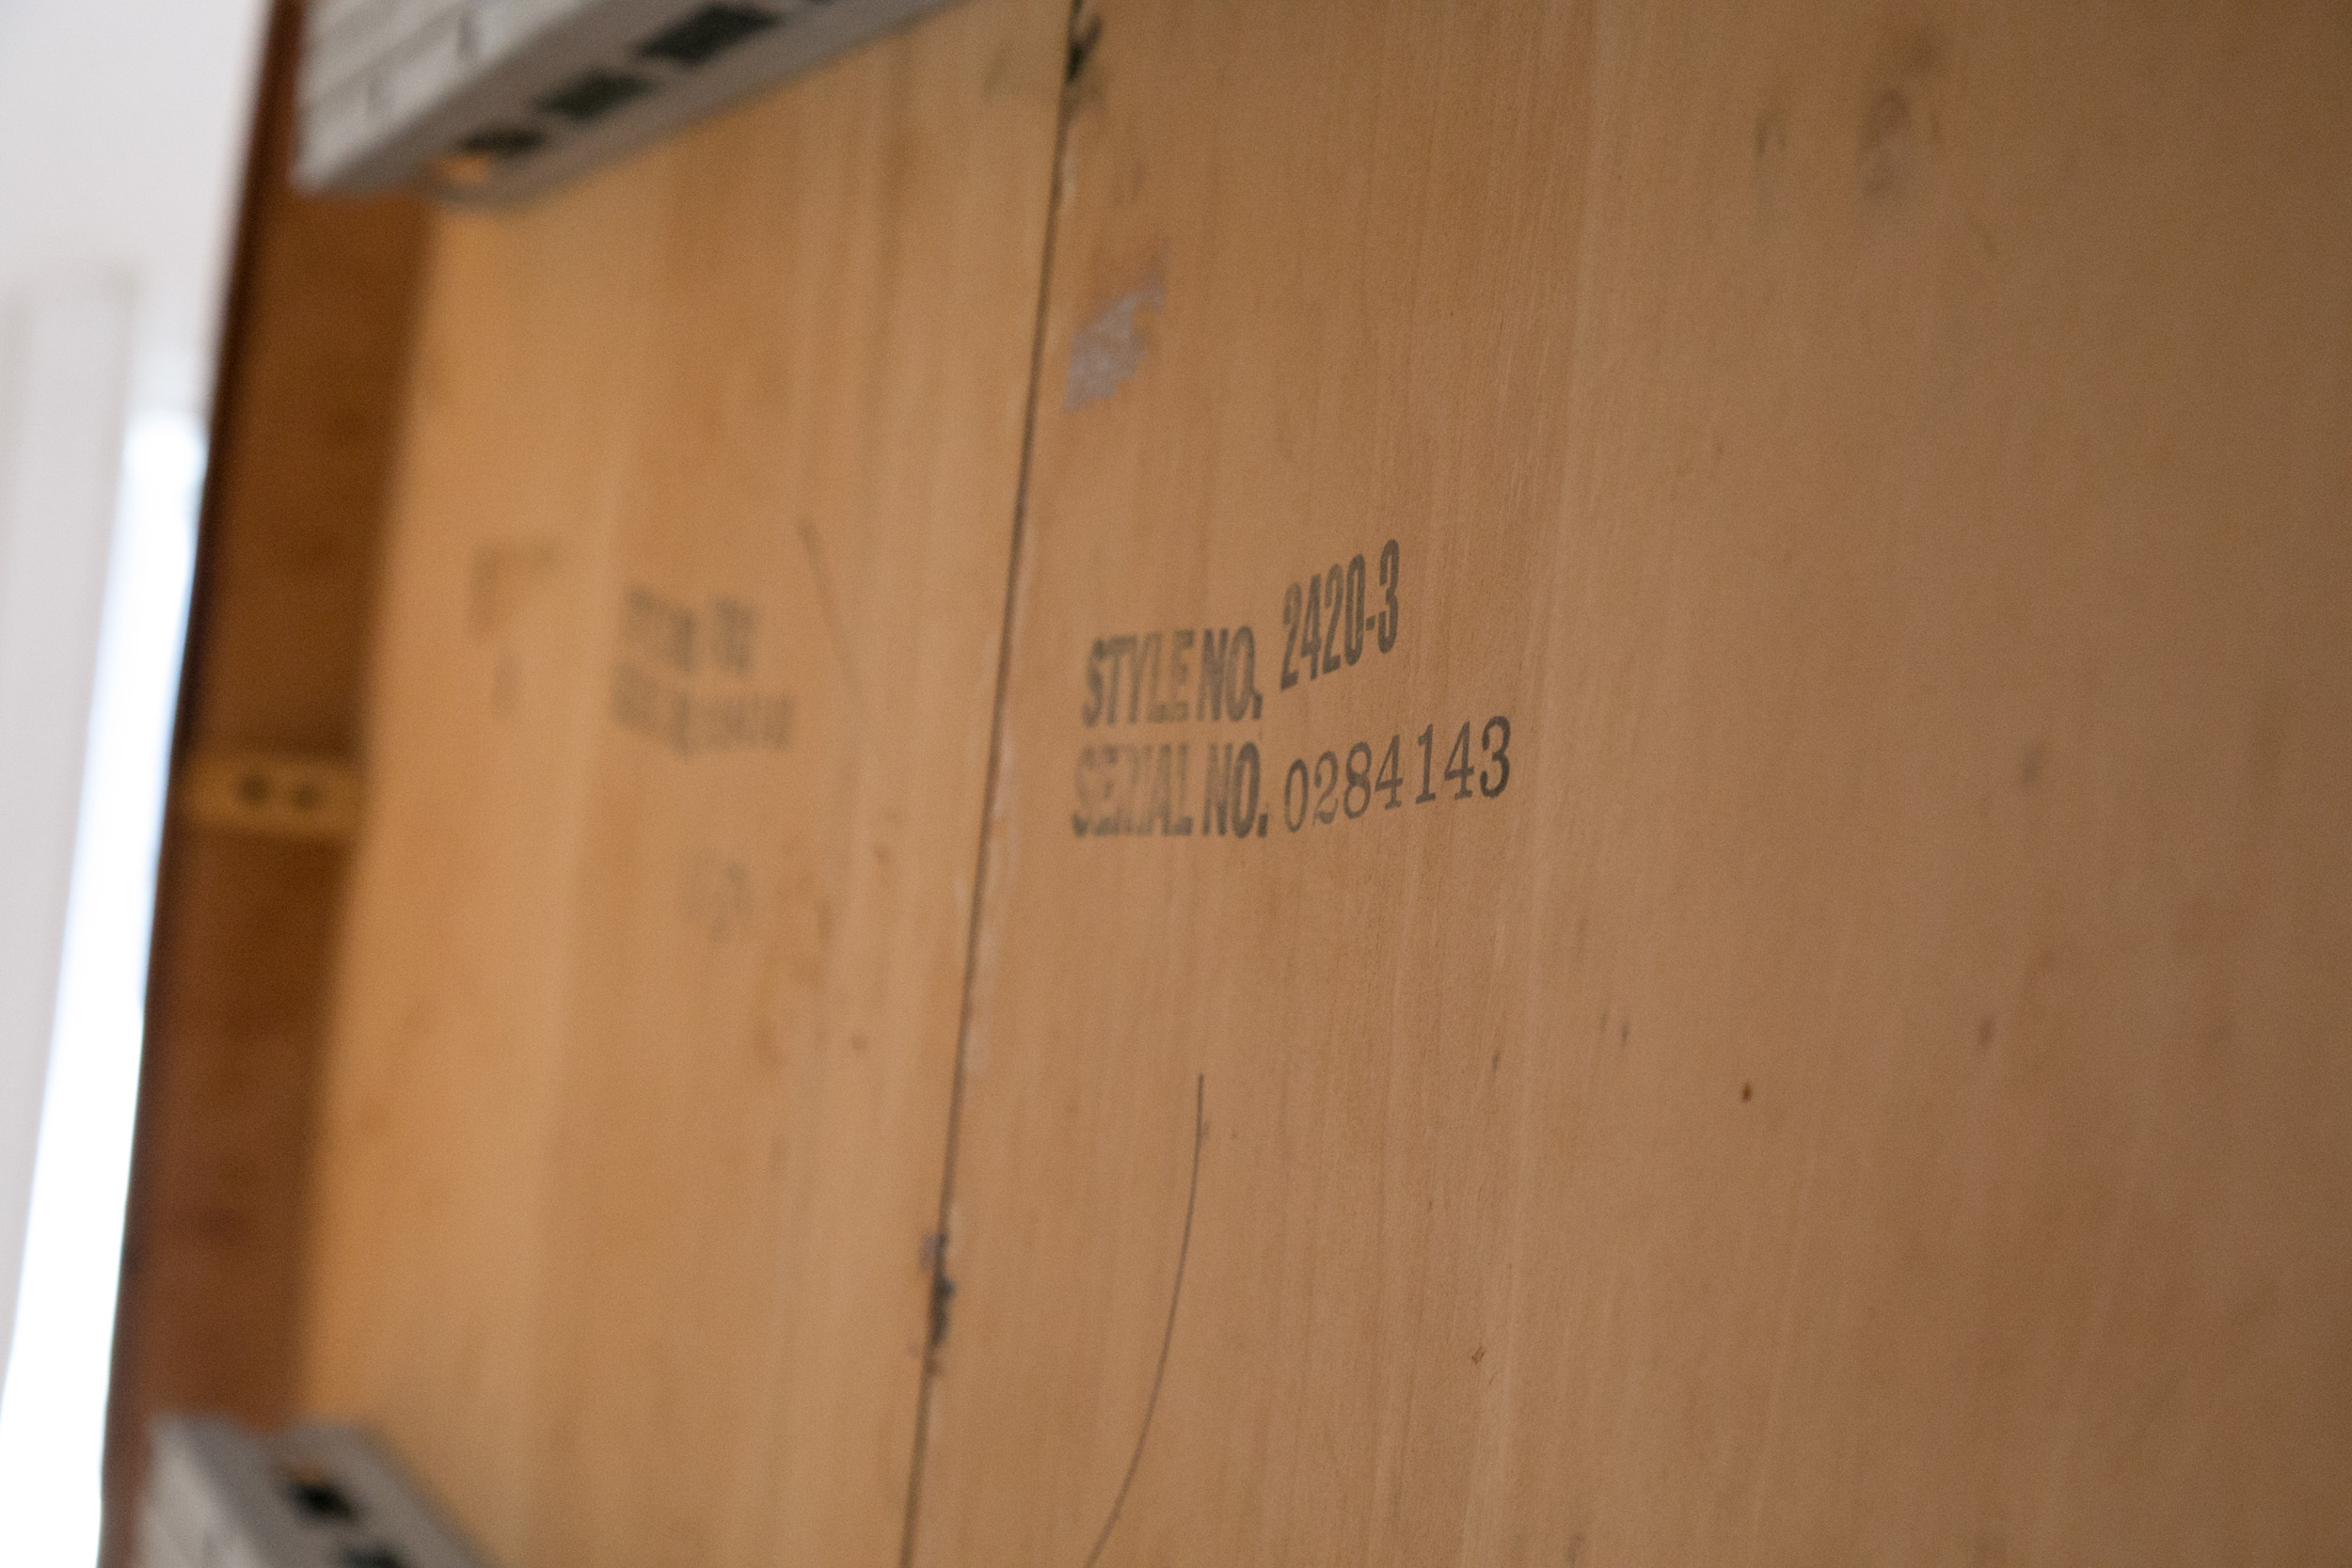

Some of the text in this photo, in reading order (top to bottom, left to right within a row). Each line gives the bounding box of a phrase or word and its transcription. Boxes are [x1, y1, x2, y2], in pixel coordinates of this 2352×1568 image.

[1082, 539, 1400, 728] STYLE NO. 2420-3
[1072, 716, 1512, 839] SERIAL NO. 0284143
